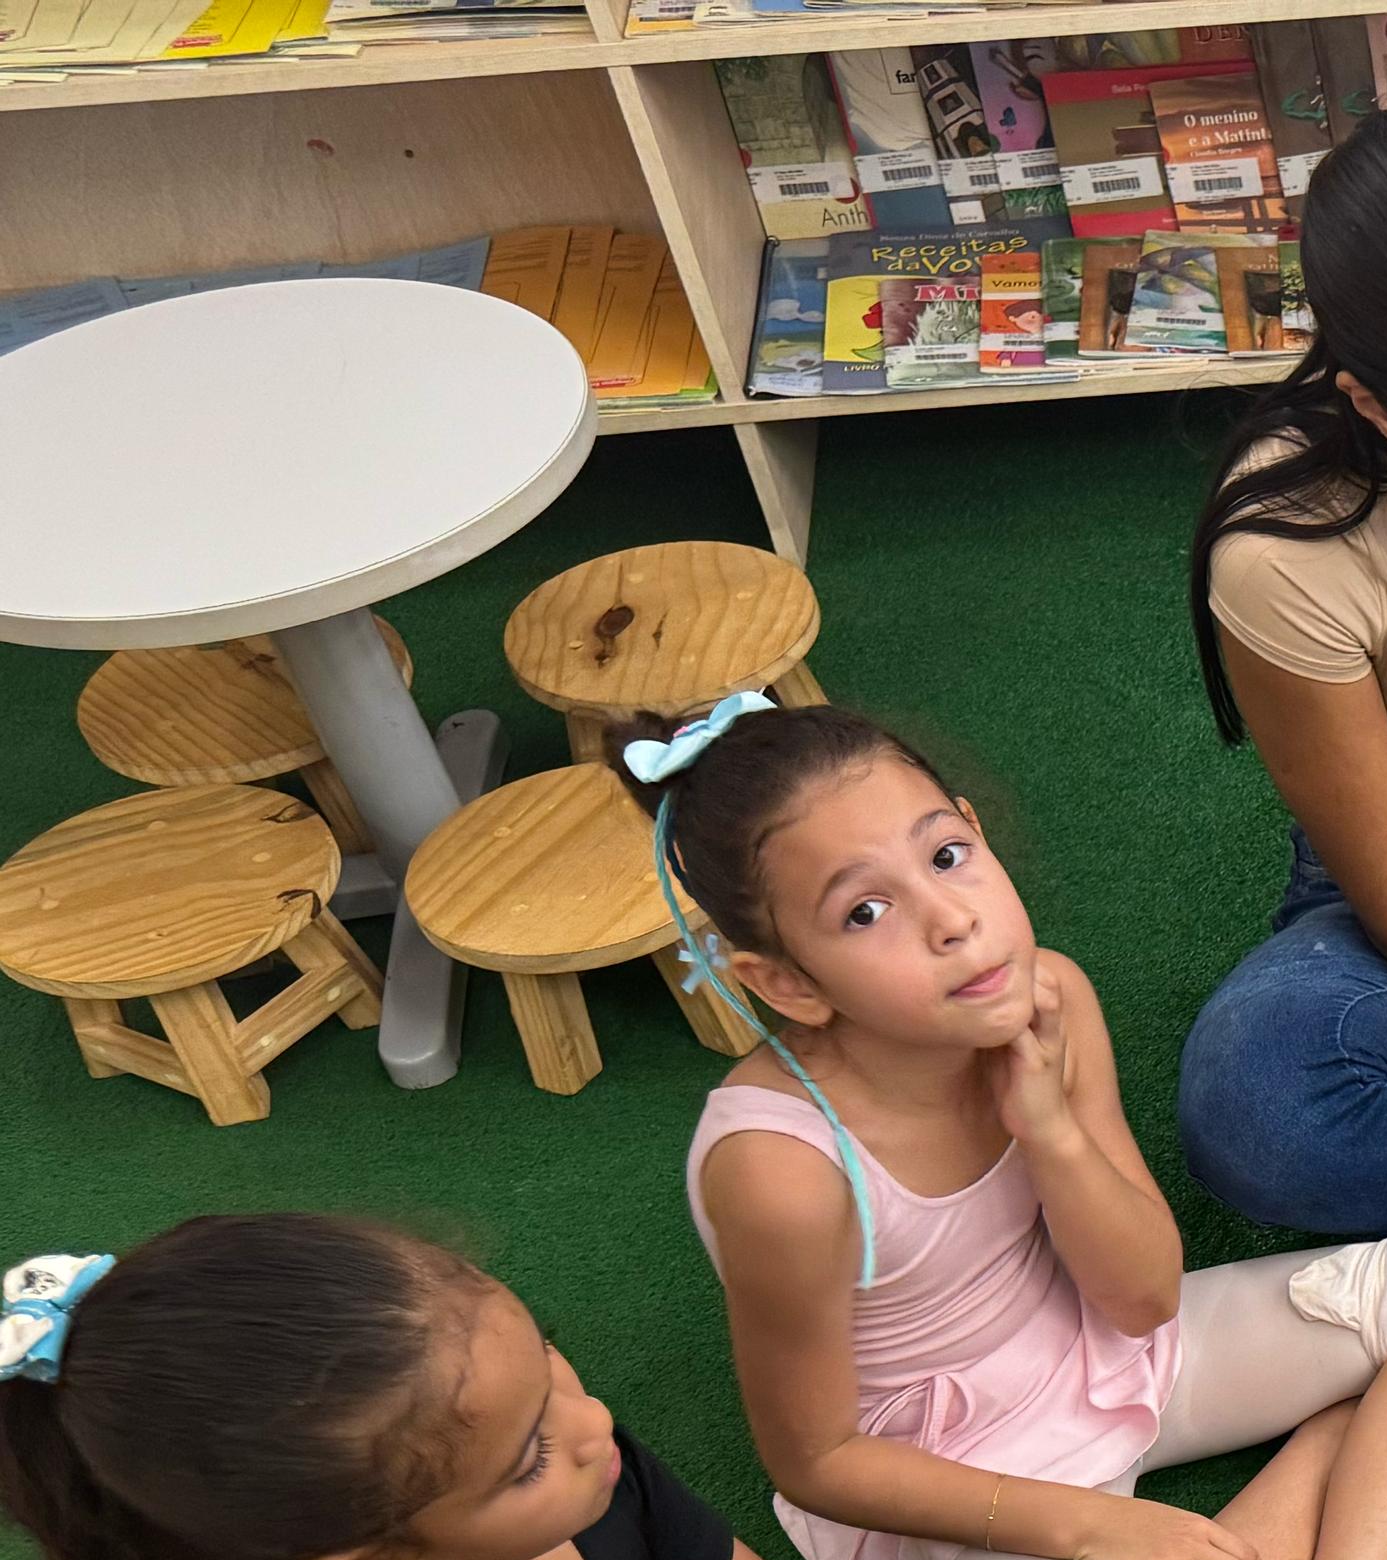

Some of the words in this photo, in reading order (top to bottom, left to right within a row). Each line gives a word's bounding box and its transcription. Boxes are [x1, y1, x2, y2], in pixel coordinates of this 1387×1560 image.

[1184, 114, 1196, 128] O
[1200, 109, 1258, 126] menino
[871, 236, 1028, 262] Receitas
